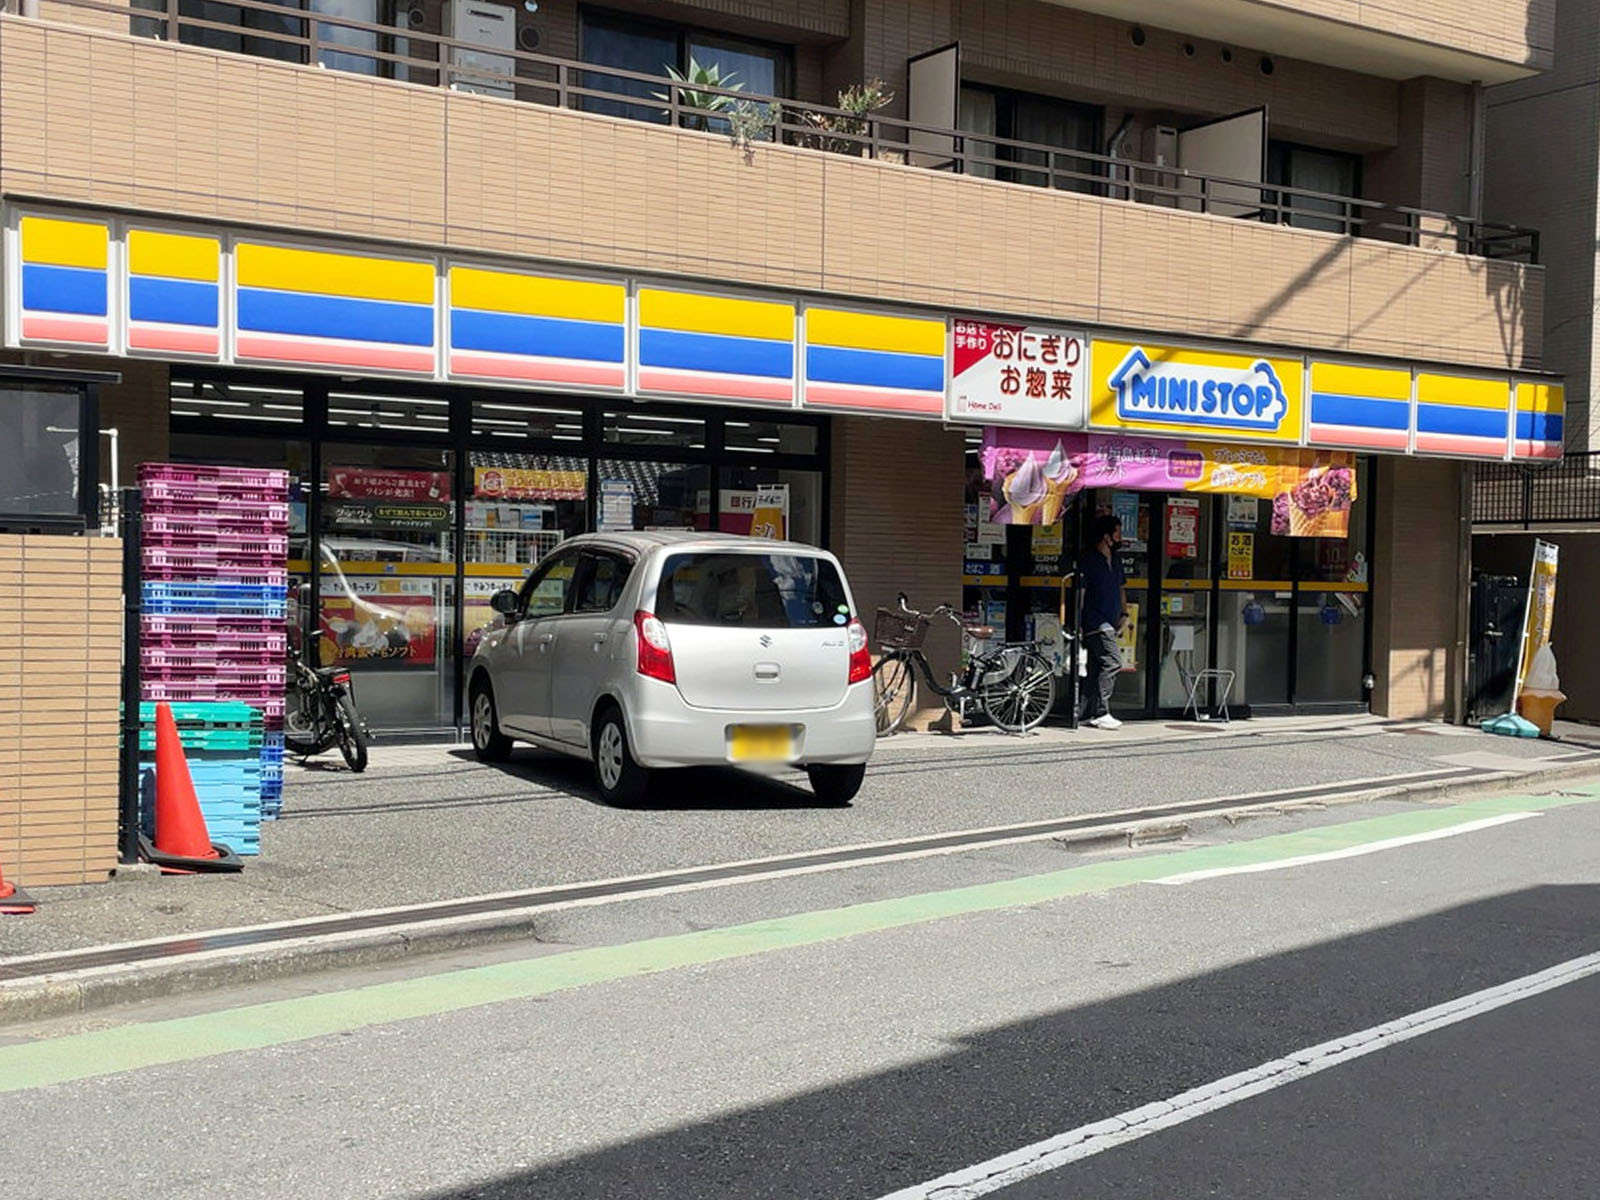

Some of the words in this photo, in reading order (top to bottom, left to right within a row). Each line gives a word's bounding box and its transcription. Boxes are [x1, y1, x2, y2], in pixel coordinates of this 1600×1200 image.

[955, 321, 987, 336] お店で
[955, 335, 988, 350] 手作り
[993, 329, 1080, 366] おにぎり
[1000, 364, 1073, 400] お惣菜
[968, 401, 987, 410] Home
